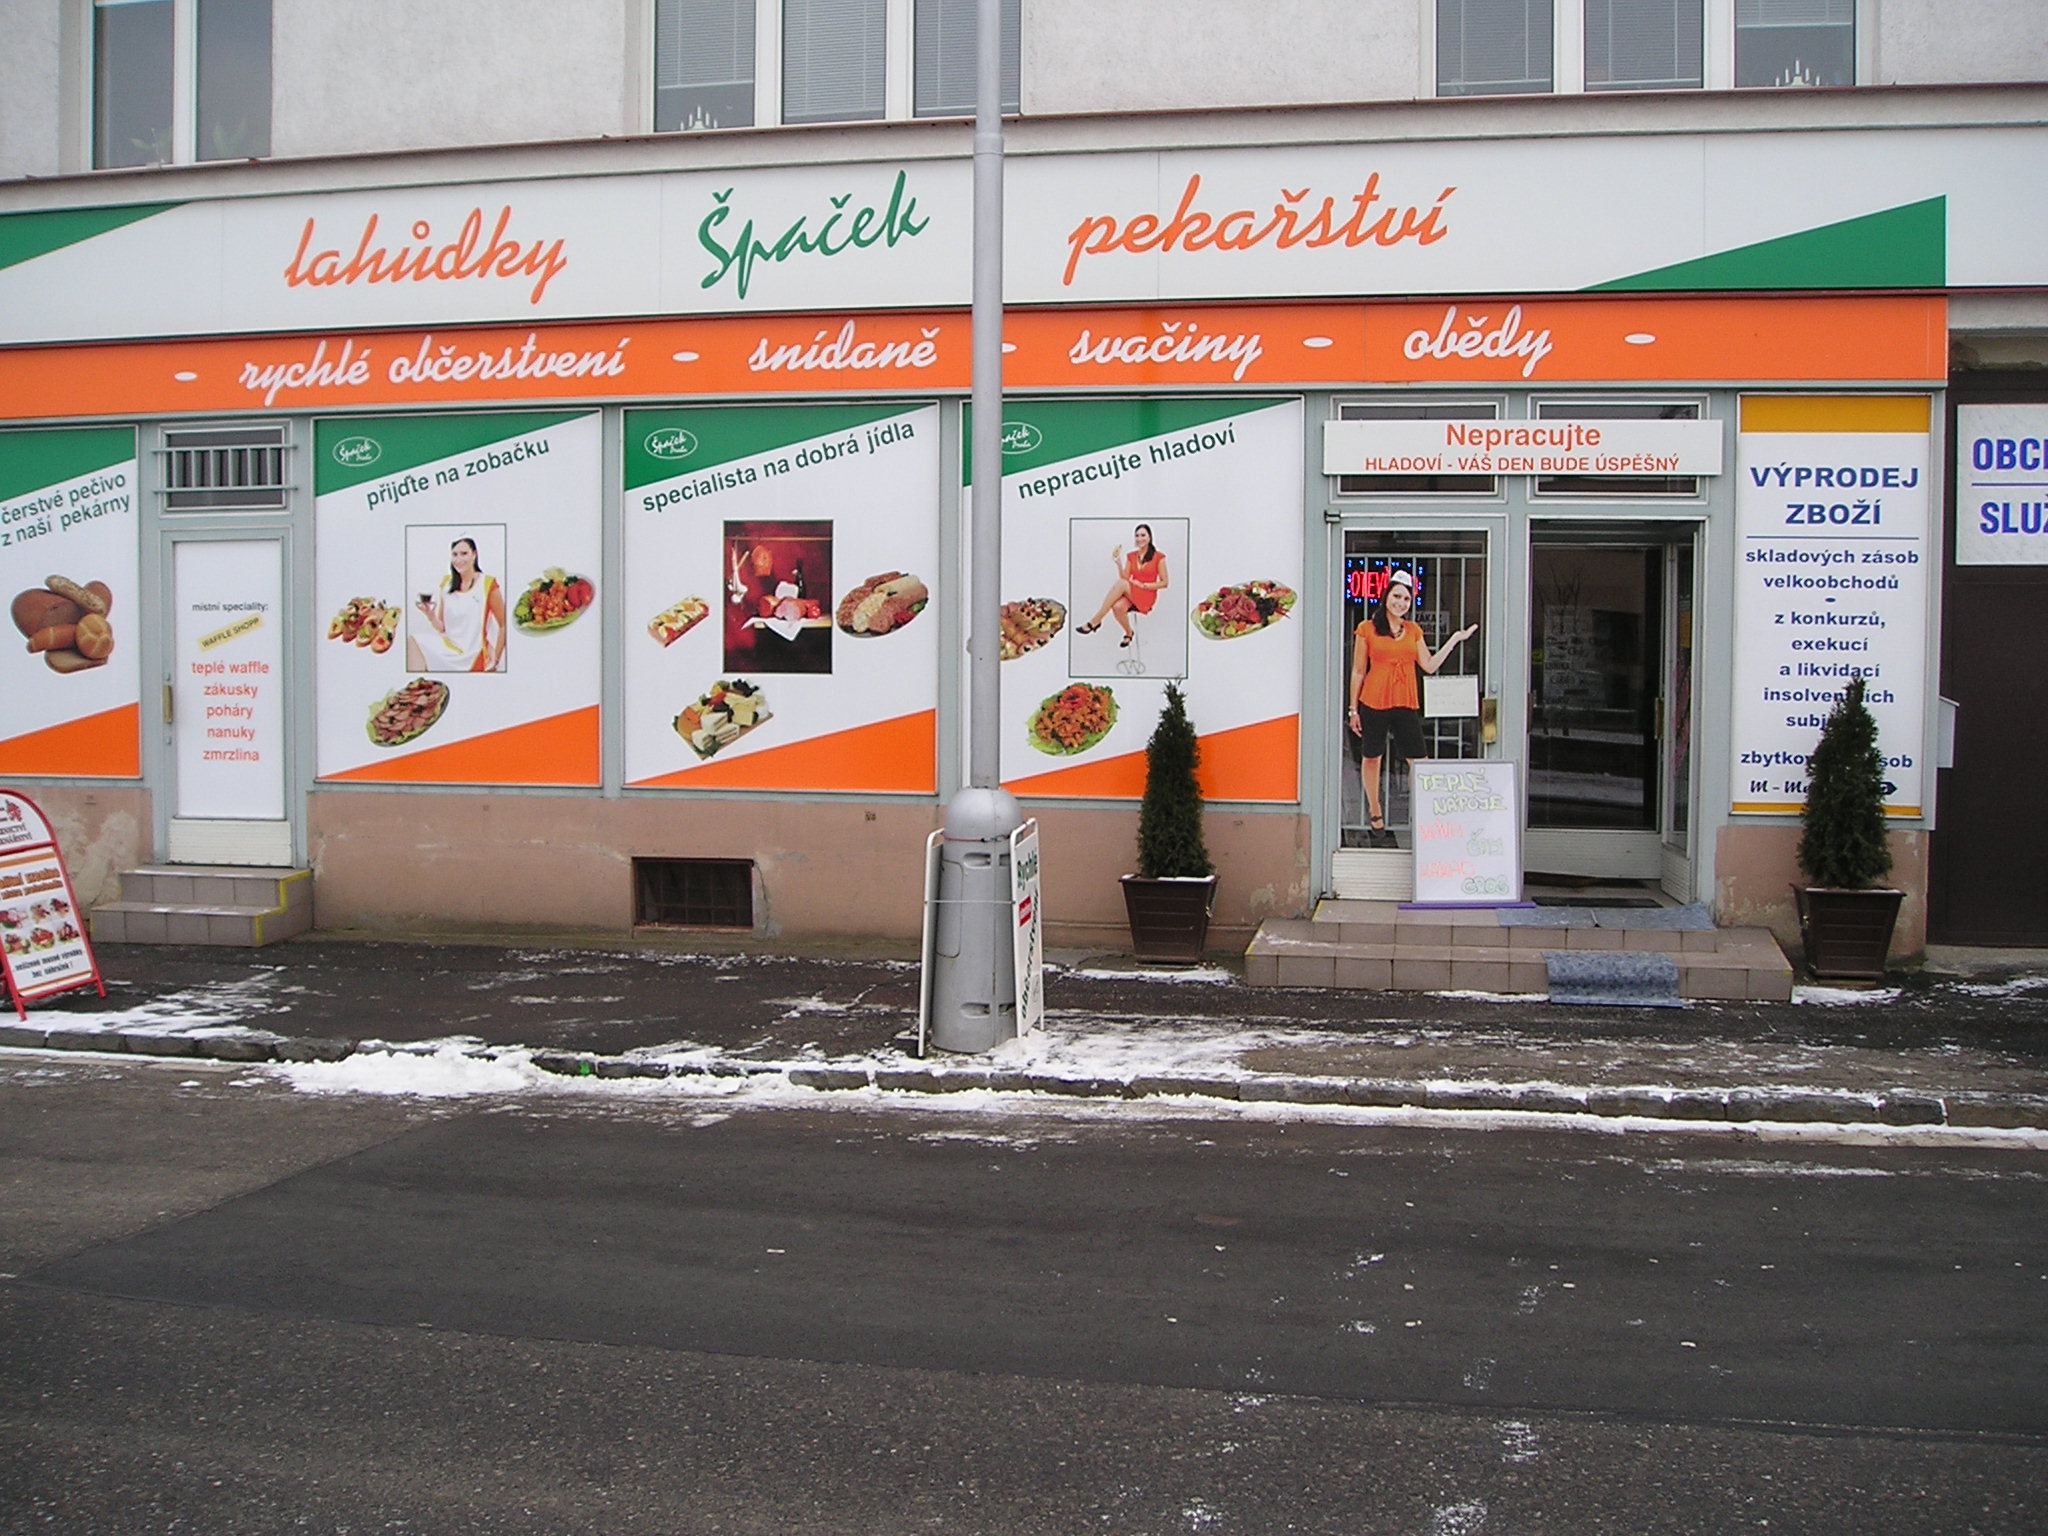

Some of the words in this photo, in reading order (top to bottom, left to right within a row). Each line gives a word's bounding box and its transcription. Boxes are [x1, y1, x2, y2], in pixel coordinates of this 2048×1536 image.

[284, 205, 567, 304] lahůdky
[698, 170, 930, 299] Špaček
[1062, 173, 1458, 286] pekařství
[239, 339, 372, 406] rychlé
[388, 333, 631, 382] občerstvení
[748, 320, 940, 371] snídaně
[1069, 321, 1262, 381] svačiny
[1403, 305, 1553, 377] obědy
[1446, 423, 1601, 451] Nepracujte
[643, 467, 757, 513] specialista
[763, 458, 791, 479] na
[795, 434, 859, 470] dobrá
[865, 422, 915, 455] jídla
[1018, 453, 1142, 499] nepracujte
[1149, 422, 1236, 464] hladoví
[1366, 453, 1442, 471] HLADOVÍ
[1458, 453, 1492, 471] VÁŠ
[1498, 457, 1535, 471] DEN
[1540, 457, 1589, 471] BUDE
[1595, 454, 1679, 471] ÚSPĚŠNÝ
[366, 475, 430, 511] přijďte
[435, 467, 460, 487] na
[464, 439, 550, 477] zobačku
[1750, 462, 1919, 488] VÝPRODEJ
[1, 490, 63, 525] čerstvé
[68, 474, 126, 507] pečivo
[1, 533, 12, 547] z
[16, 515, 52, 542] naší
[60, 495, 130, 531] pekárny
[1786, 499, 1881, 525] ZBOŽÍ
[1746, 549, 1855, 567] skladových
[1861, 550, 1919, 564] zásob
[1763, 574, 1899, 589] velkoobchodů
[222, 602, 269, 612] speciality:
[1774, 614, 1784, 624] z
[1791, 611, 1886, 629] konkurzů,
[202, 629, 232, 648] WAFFLE
[1791, 637, 1868, 651] exekucí
[192, 660, 225, 675] teplé
[229, 661, 269, 674] waffle
[1779, 665, 1790, 676] a
[1798, 663, 1880, 677] likvidací
[204, 683, 258, 698] zákusky
[1763, 688, 1894, 703] insolveních
[207, 703, 253, 719] poháry
[207, 726, 255, 741] nanuky
[203, 749, 260, 761] zmrzlina
[1419, 767, 1491, 793] TEPLÉ
[1433, 793, 1508, 815] NÁPOJE
